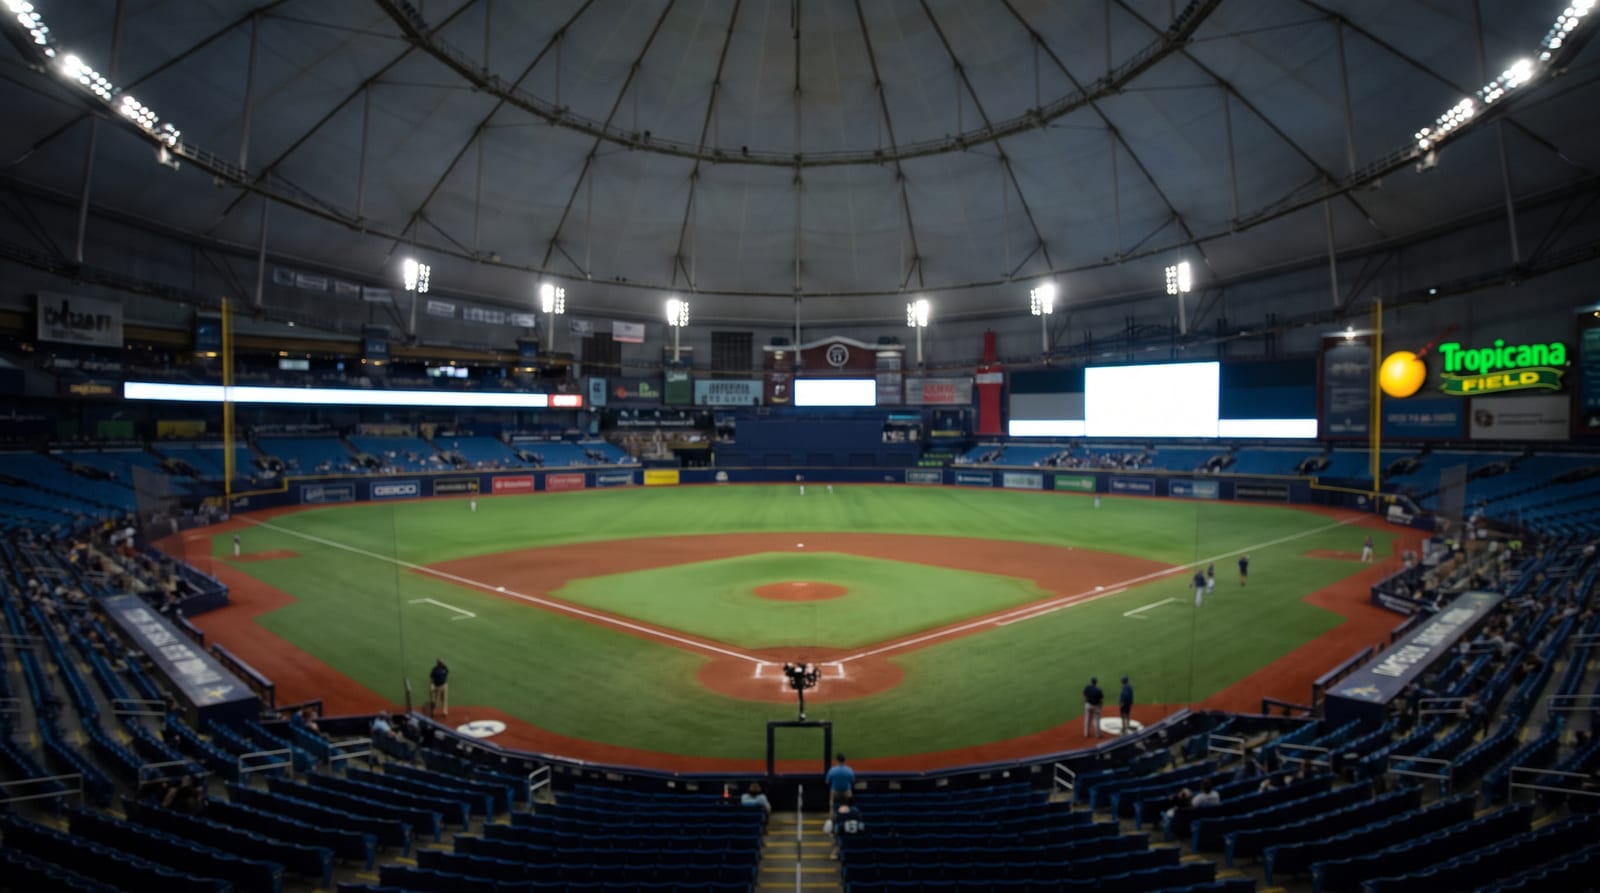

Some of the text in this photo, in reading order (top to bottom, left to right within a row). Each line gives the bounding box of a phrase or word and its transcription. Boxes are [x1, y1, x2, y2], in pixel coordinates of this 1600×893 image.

[1438, 339, 1566, 374] Tropicana
[1463, 372, 1540, 392] FIELD
[374, 484, 416, 496] GEICO
